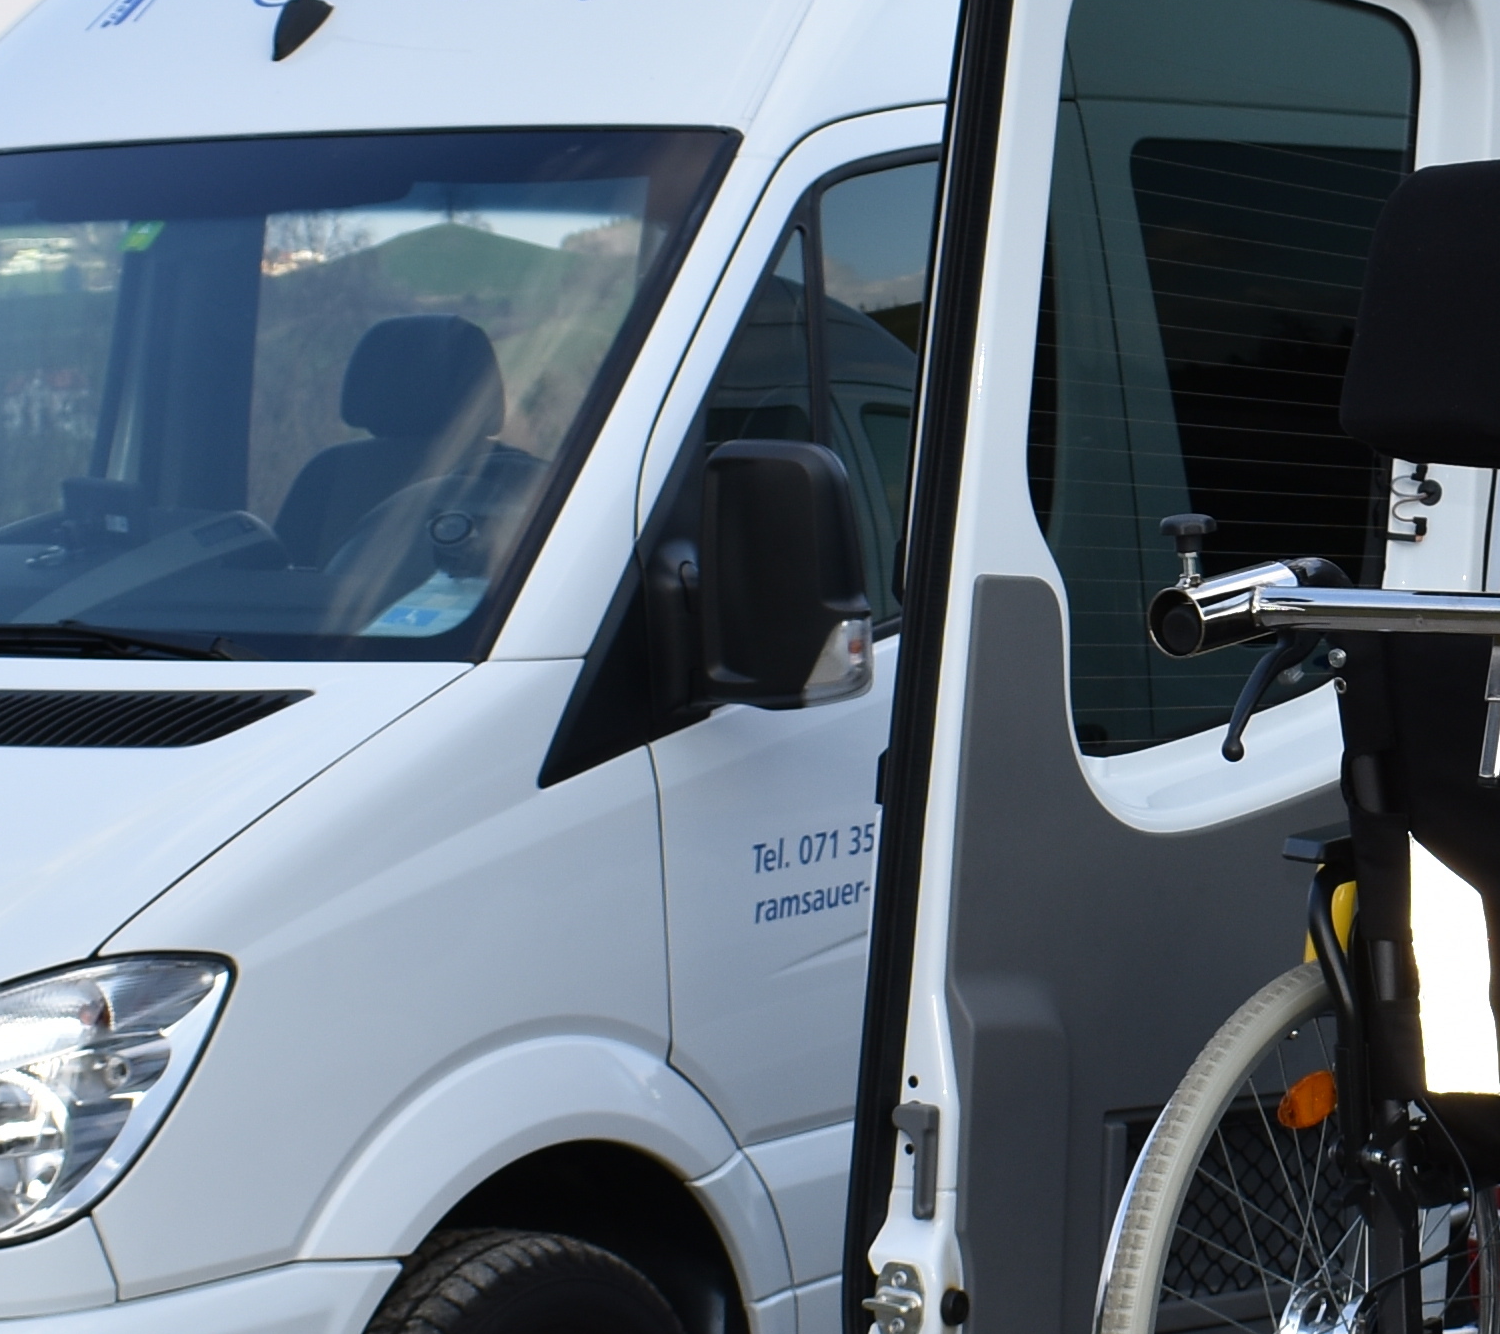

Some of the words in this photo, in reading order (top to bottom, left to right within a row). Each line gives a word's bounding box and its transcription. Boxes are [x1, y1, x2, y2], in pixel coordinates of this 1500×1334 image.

[753, 837, 790, 873] Tel.
[799, 829, 839, 866] 071
[754, 879, 871, 924] ramsauer-
